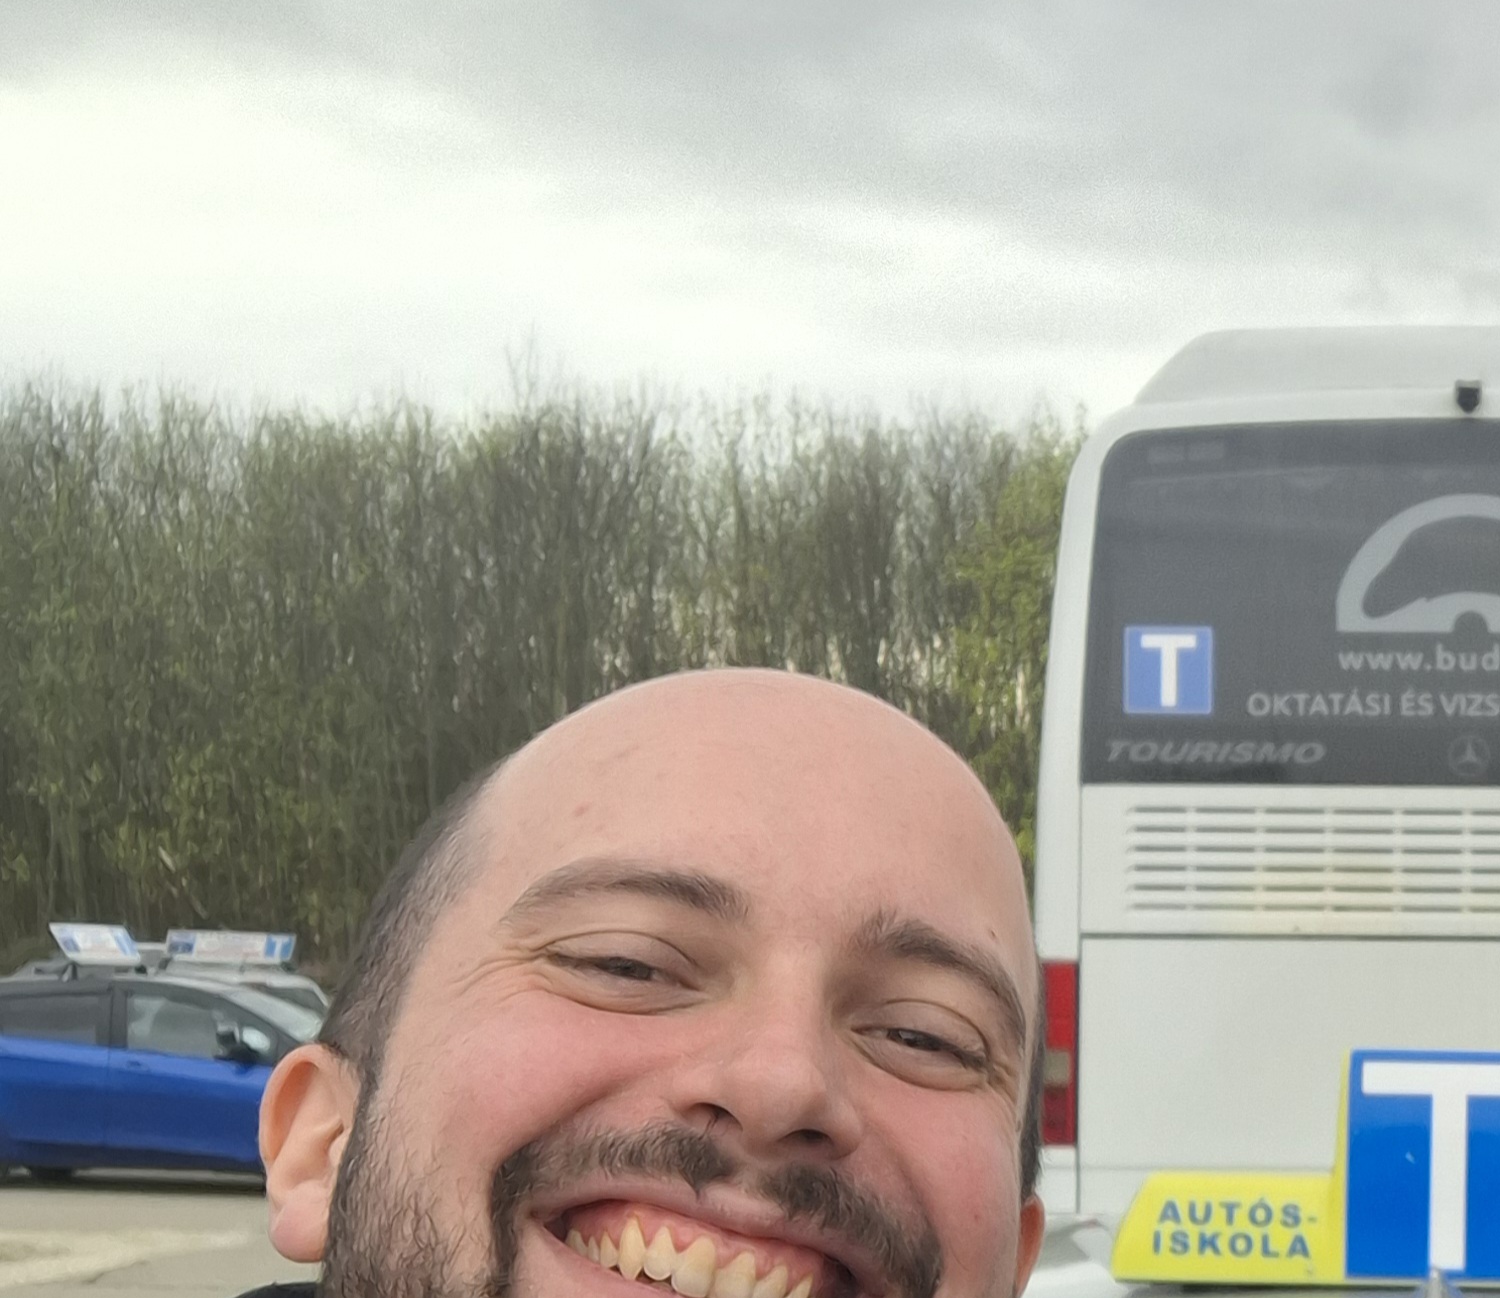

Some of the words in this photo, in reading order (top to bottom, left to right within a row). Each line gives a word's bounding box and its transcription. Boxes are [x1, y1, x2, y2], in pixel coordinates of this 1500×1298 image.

[1141, 634, 1197, 707] T
[1247, 686, 1391, 717] OKTATÁSI
[1399, 686, 1434, 717] ÉS
[1106, 739, 1328, 764] TOURISMO
[1158, 1196, 1318, 1229] AUTÓS-
[1152, 1229, 1312, 1259] ISKOLA
